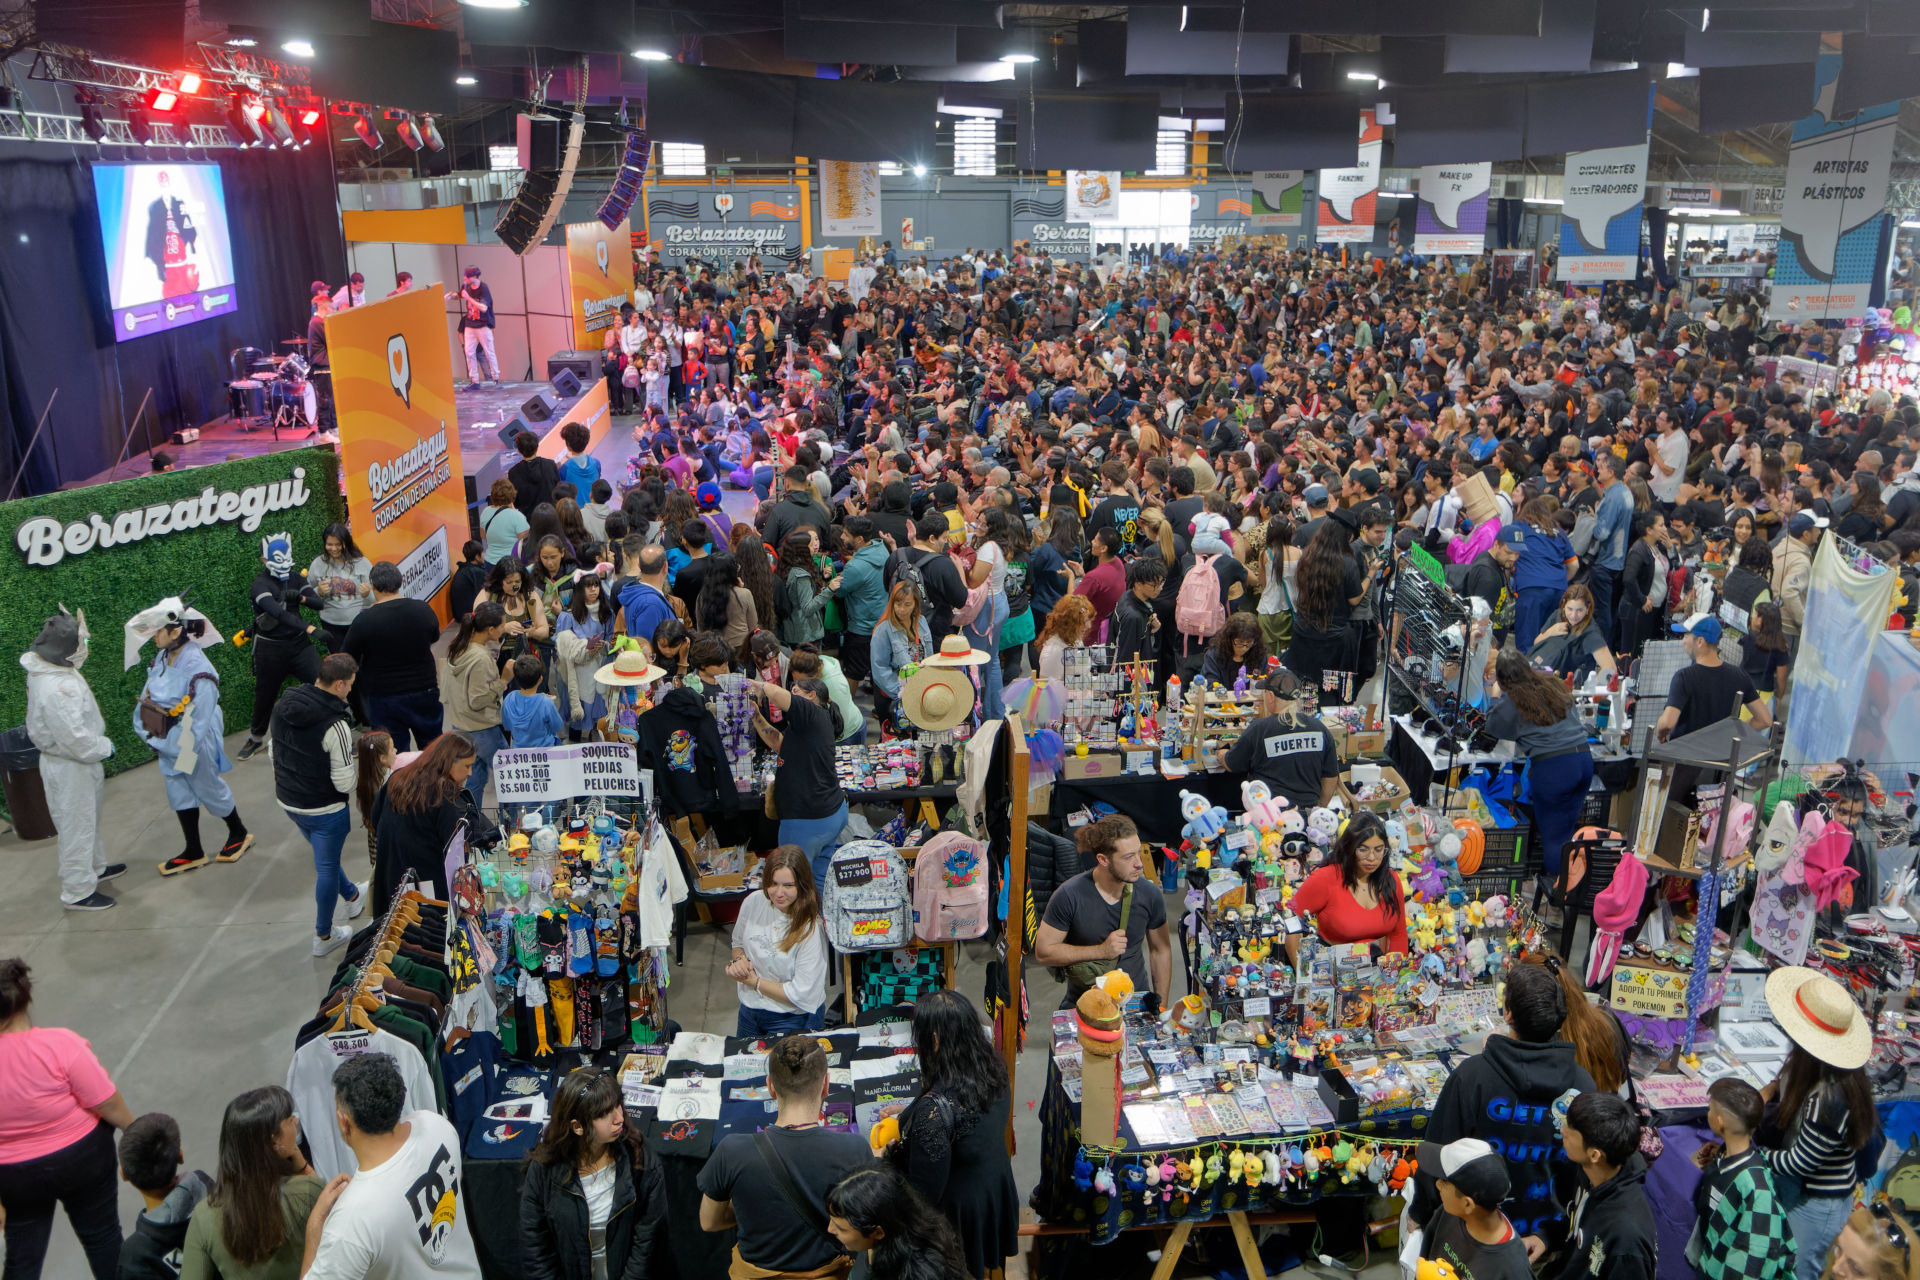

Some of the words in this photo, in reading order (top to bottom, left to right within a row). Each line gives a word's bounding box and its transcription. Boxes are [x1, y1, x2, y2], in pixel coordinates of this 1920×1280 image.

[1813, 160, 1869, 174] ARTISTAS
[1439, 171, 1462, 180] MAKE
[1462, 172, 1472, 180] UP
[1451, 184, 1462, 192] FX
[1803, 183, 1865, 200] PLÁSTICOS
[666, 224, 786, 247] Berazategui
[668, 245, 718, 257] CORAZÓN
[720, 247, 733, 256] DE
[736, 247, 764, 256] ZONA
[765, 247, 786, 256] SUR
[368, 420, 447, 501] Berazategui
[375, 490, 410, 532] CORAZÓN
[410, 486, 420, 508] DE
[420, 476, 437, 502] ZONA
[436, 463, 450, 487] SUR
[16, 467, 311, 566] Berazategui
[1114, 507, 1138, 521] NEVER
[1274, 737, 1317, 753] FUERTE
[498, 755, 502, 764] 3
[505, 754, 511, 764] X
[513, 752, 548, 765] $10.000
[582, 745, 629, 760] SOQUETES
[499, 771, 505, 780] 3
[507, 770, 512, 779] X
[515, 768, 549, 780] $13.000
[583, 762, 622, 774] MEDIAS
[500, 782, 530, 794] $5.500
[584, 778, 636, 791] PELUCHES
[838, 868, 870, 880] $27.900
[841, 863, 864, 871] MOCHILA
[870, 862, 887, 876] VEL
[852, 918, 892, 936] COMICS
[1618, 984, 1645, 996] ADOPTA
[1647, 988, 1655, 996] TU
[1656, 989, 1683, 1000] PRIMER
[332, 1038, 369, 1051] $48.300
[864, 1084, 911, 1096] MANDALORIAN
[1487, 1097, 1549, 1125] GET
